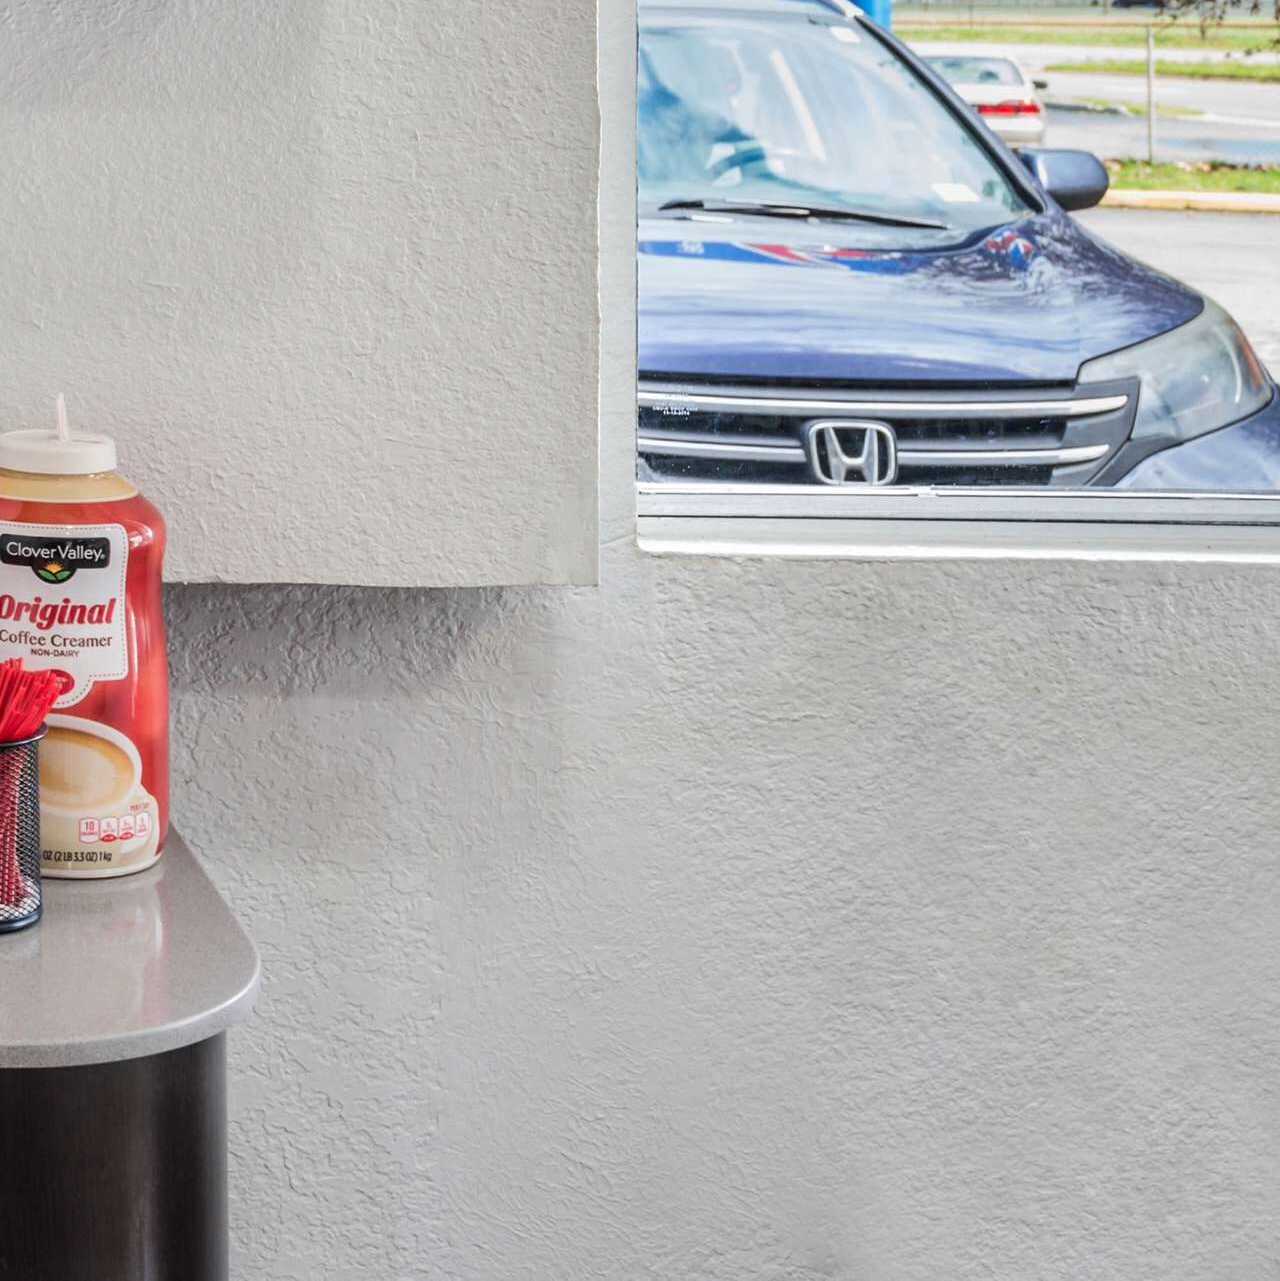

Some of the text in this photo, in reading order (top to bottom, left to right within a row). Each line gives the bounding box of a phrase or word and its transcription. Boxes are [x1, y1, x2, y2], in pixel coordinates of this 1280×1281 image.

[6, 540, 56, 559] Clover
[50, 634, 112, 649] Creamer
[30, 647, 80, 658] NON-DAIRY
